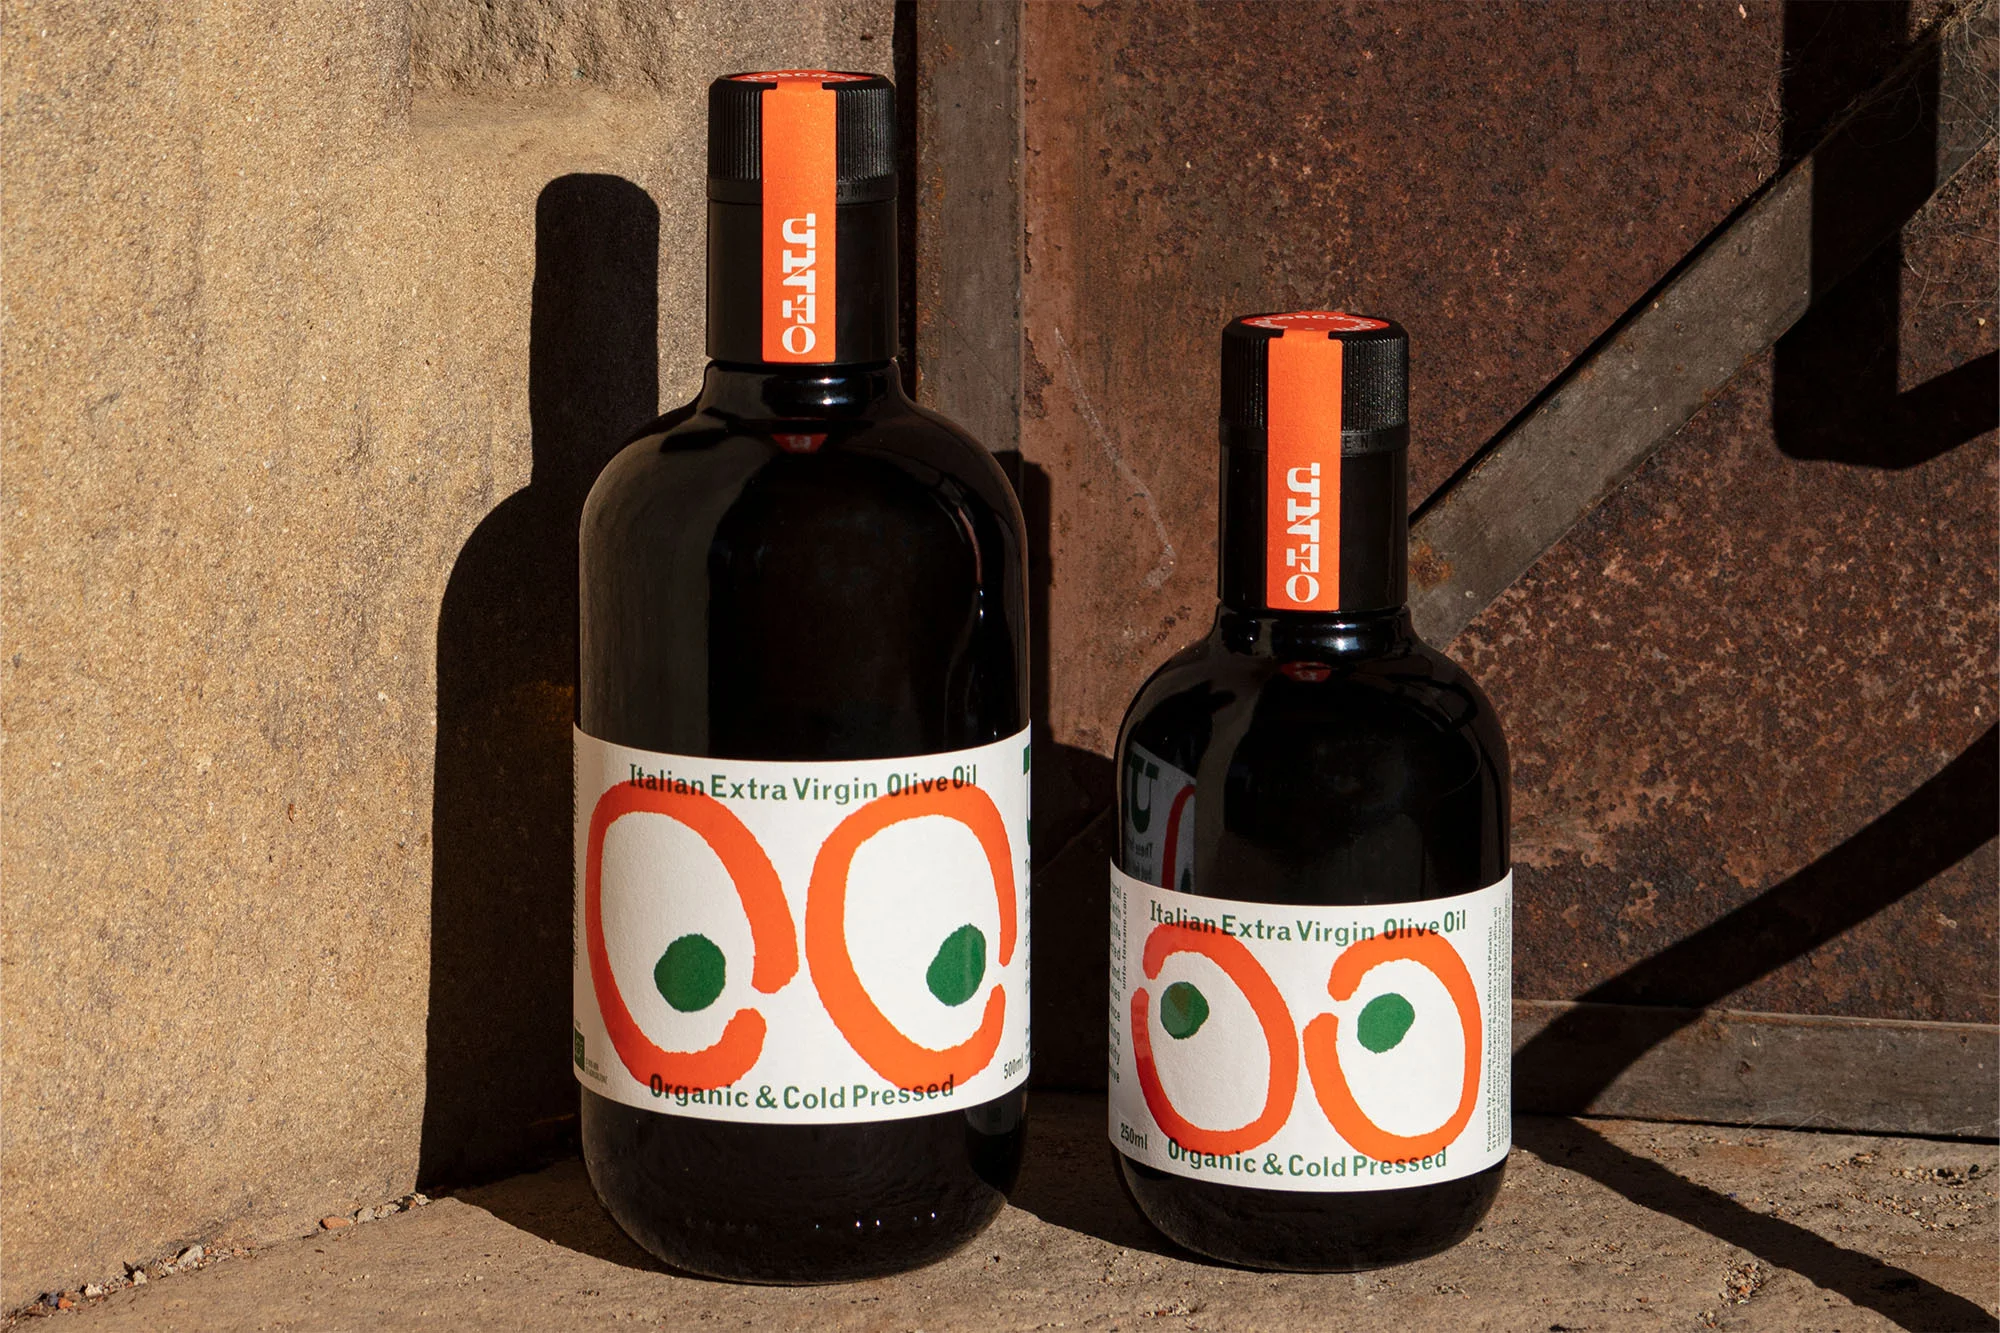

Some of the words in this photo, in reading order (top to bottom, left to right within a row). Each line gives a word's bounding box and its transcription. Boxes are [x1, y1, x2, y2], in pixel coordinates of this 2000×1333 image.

[782, 212, 816, 354] UNTO
[1286, 462, 1320, 603] UNTO
[629, 763, 705, 796] Italian
[711, 774, 787, 801] Extra
[792, 777, 878, 805] Virgin
[886, 772, 948, 798] Olive
[952, 764, 978, 788] Oil
[1150, 900, 1216, 934] Italian
[1221, 914, 1292, 940] Extra
[1296, 920, 1374, 946] Virgin
[1384, 918, 1440, 940] Olive
[1444, 910, 1466, 933] Oil
[1003, 1052, 1024, 1080] 500ml
[649, 1072, 748, 1108] Organic
[755, 1085, 778, 1110] &
[783, 1085, 846, 1110] Cold
[853, 1074, 954, 1108] Pressed
[1120, 1122, 1148, 1150] 250ml
[1168, 1136, 1256, 1174] Organic
[1262, 1152, 1283, 1176] &
[1288, 1154, 1346, 1177] Cold
[1352, 1146, 1447, 1176] Pressed
